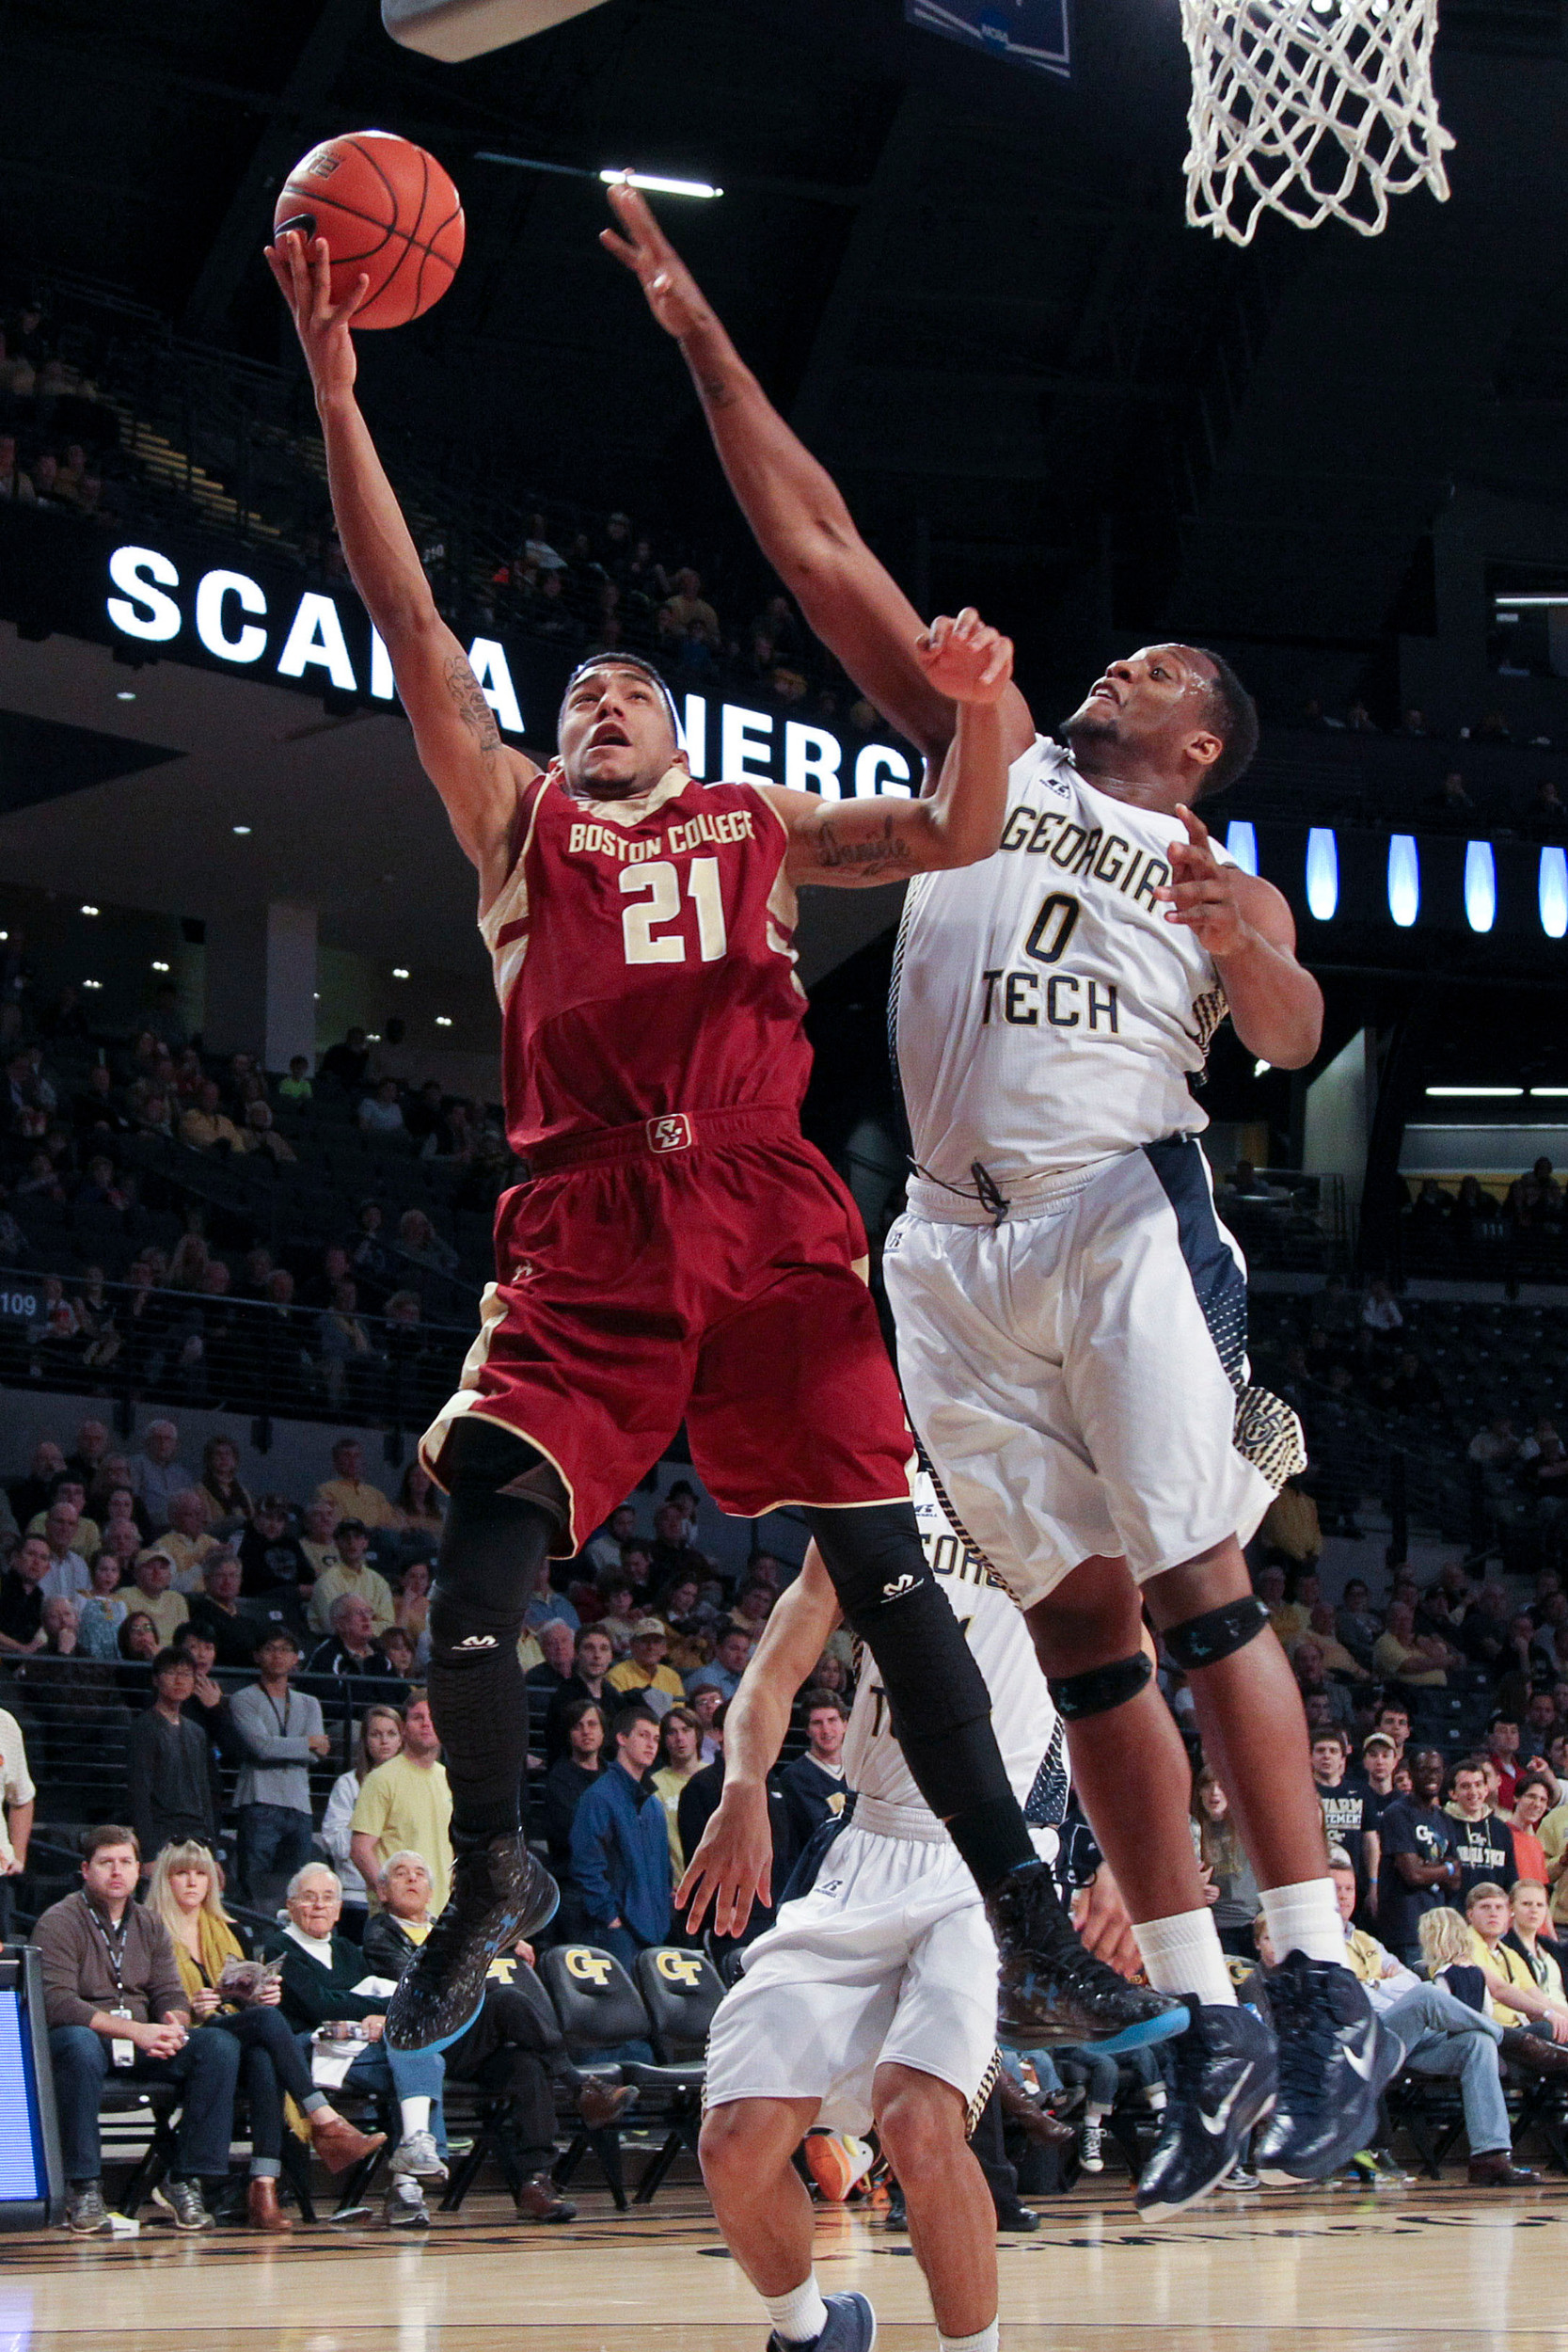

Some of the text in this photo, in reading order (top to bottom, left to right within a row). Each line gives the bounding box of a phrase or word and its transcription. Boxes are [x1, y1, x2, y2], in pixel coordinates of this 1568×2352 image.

[664, 688, 927, 801] NERG
[569, 810, 755, 863] BOSTON COLLEGE
[999, 805, 1172, 914] GEORGIA
[618, 856, 727, 964] 21
[1024, 890, 1081, 964] 0
[981, 969, 1119, 1034] TECH
[0, 1292, 36, 1316] 109
[565, 1949, 612, 1986] GT
[657, 1950, 703, 1986] GT
